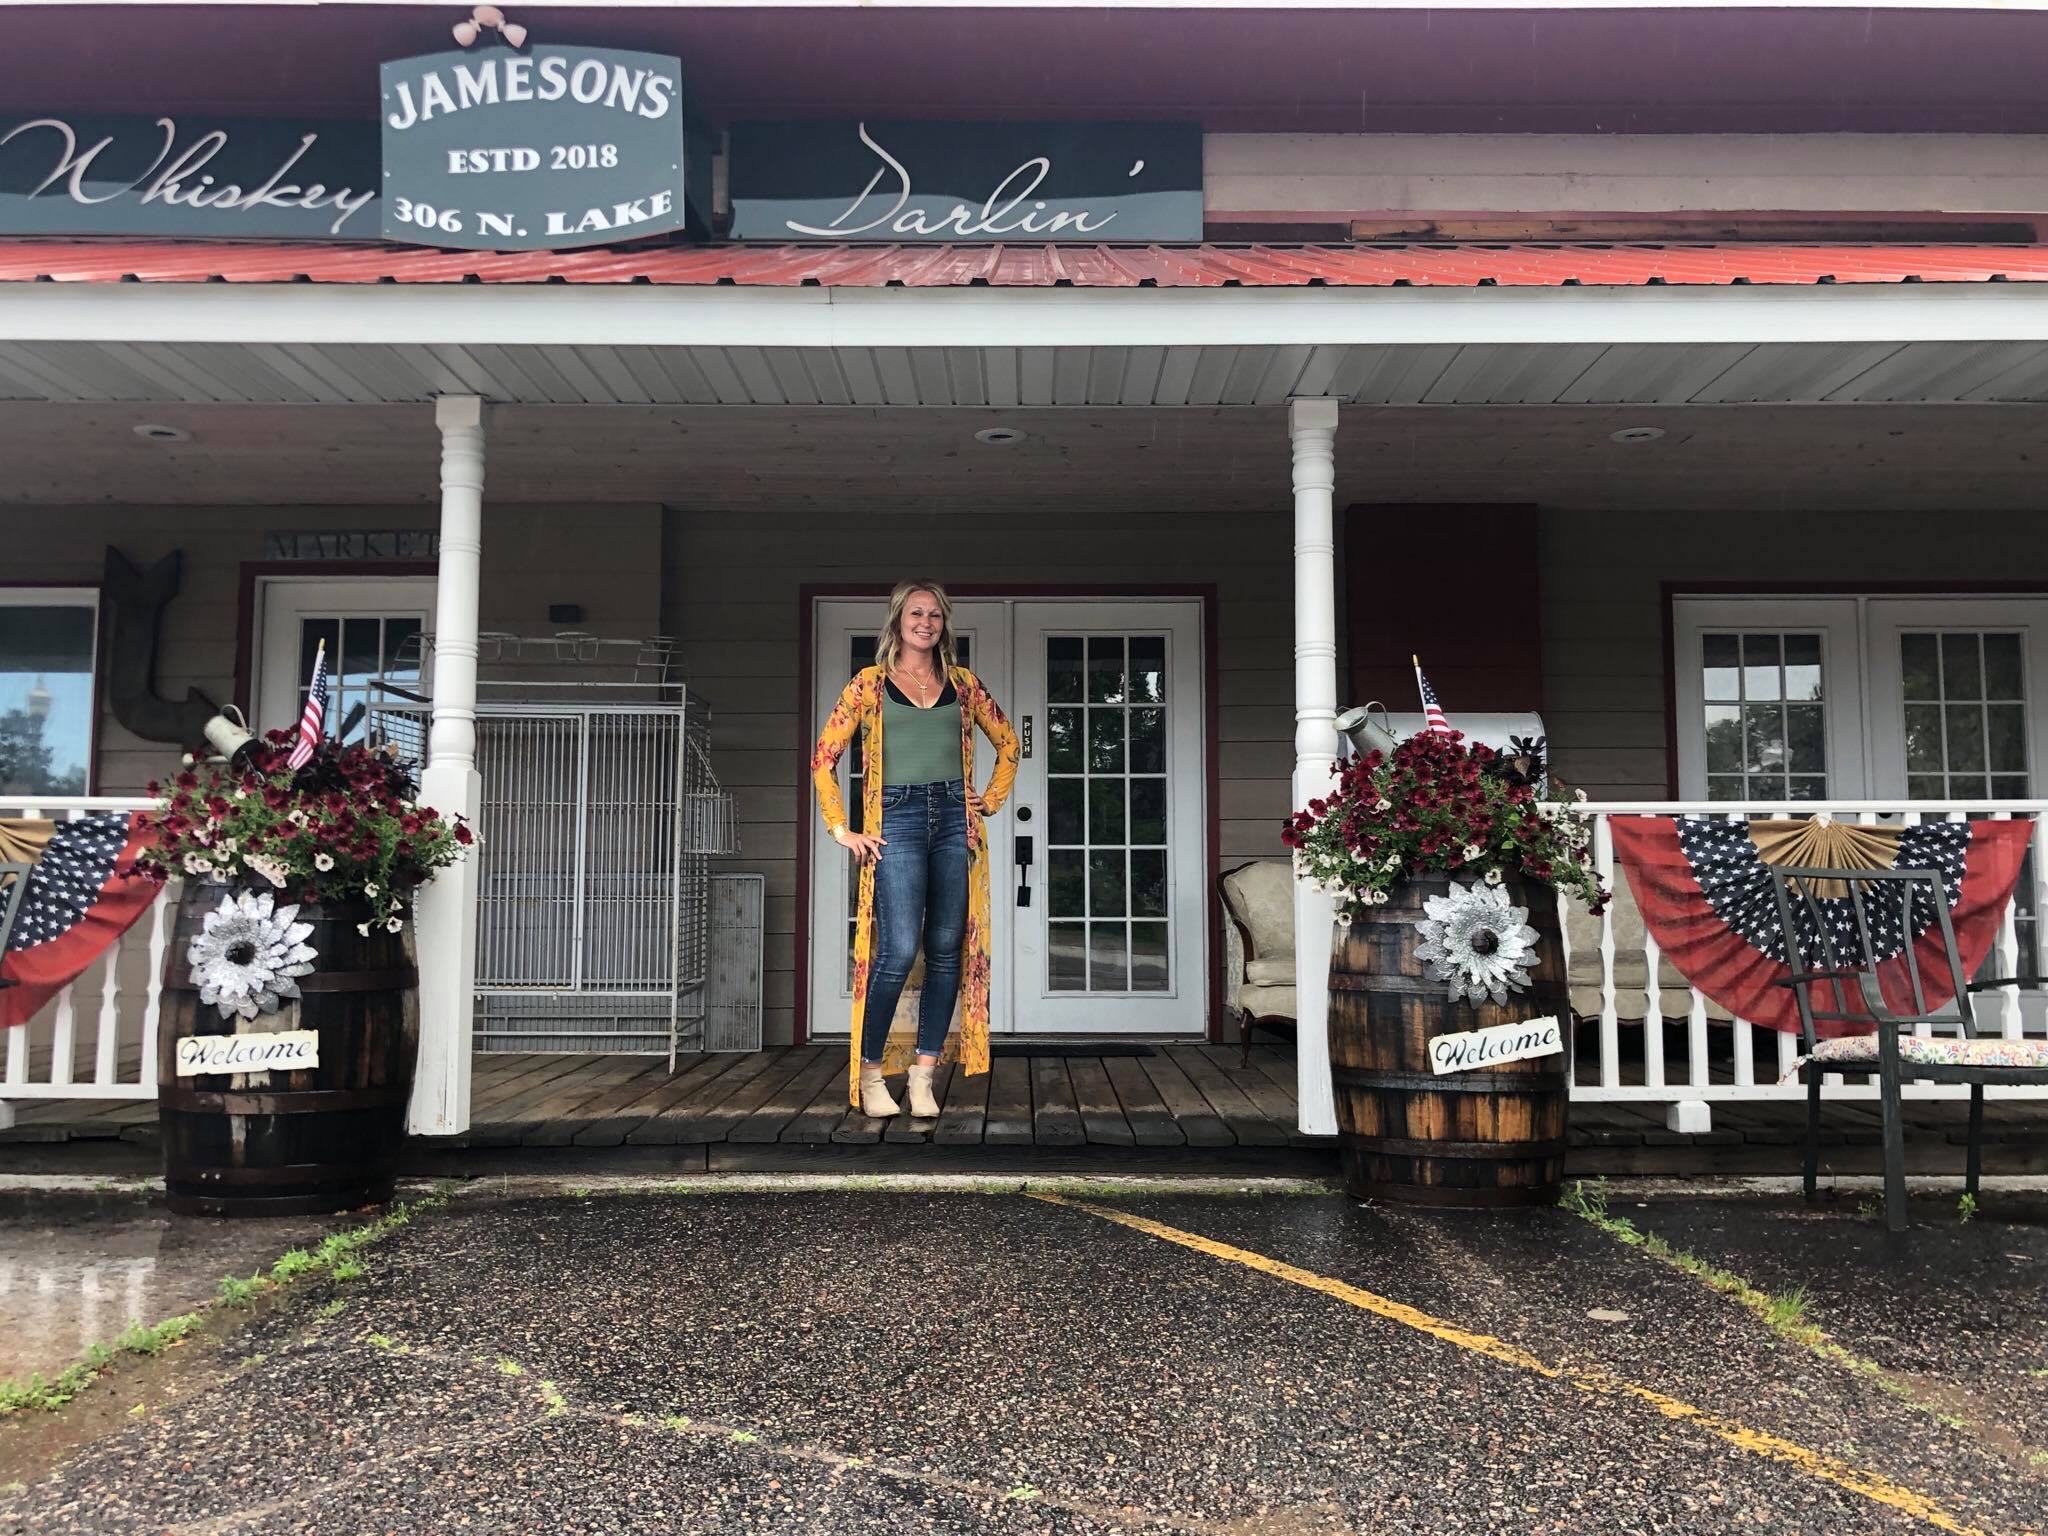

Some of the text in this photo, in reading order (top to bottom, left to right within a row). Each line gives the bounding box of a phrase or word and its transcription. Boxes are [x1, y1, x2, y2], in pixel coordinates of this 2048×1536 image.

[388, 57, 673, 130] JAMESON'S
[0, 117, 376, 234] Whiskey
[447, 144, 618, 174] ESTD 2018
[393, 189, 673, 238] 306 N. LAKE
[181, 1039, 312, 1066] Welcome
[1436, 1028, 1555, 1067] Welcome
